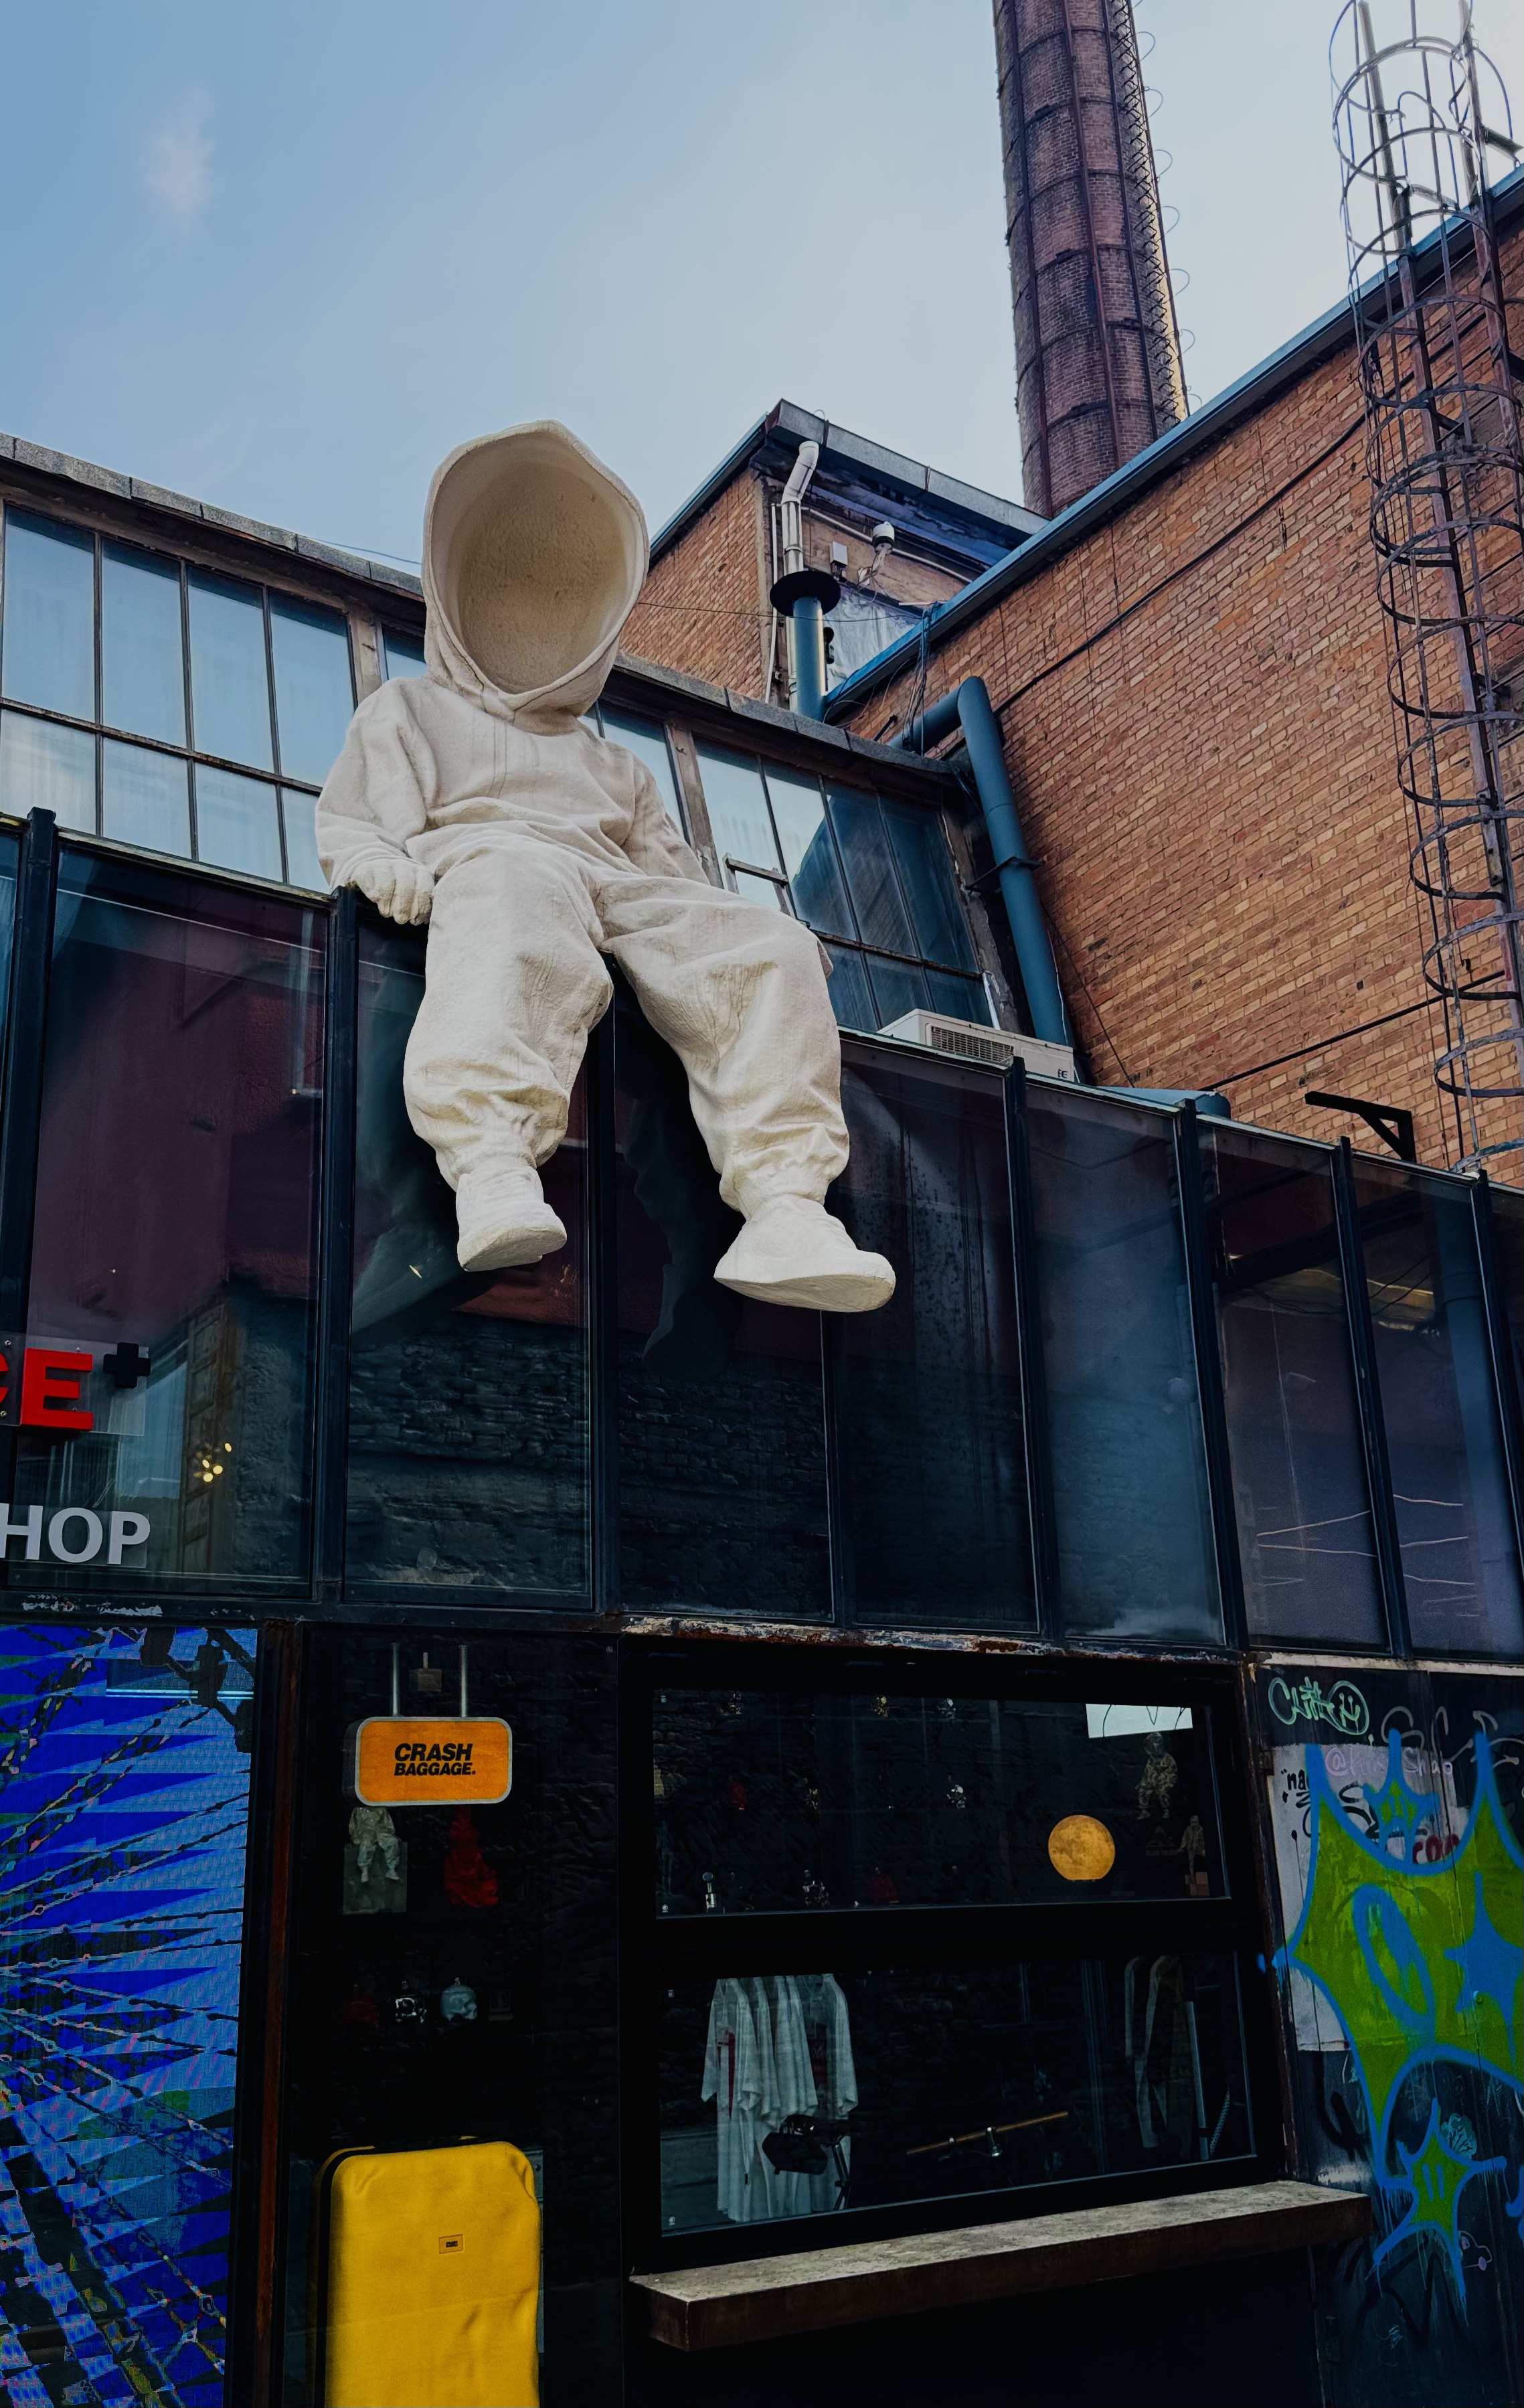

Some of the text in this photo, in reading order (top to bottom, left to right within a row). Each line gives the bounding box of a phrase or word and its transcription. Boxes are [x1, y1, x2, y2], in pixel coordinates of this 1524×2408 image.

[0, 1502, 151, 1565] HOP
[394, 1743, 473, 1761] CRASH
[394, 1762, 477, 1776] BAGGAGE.
